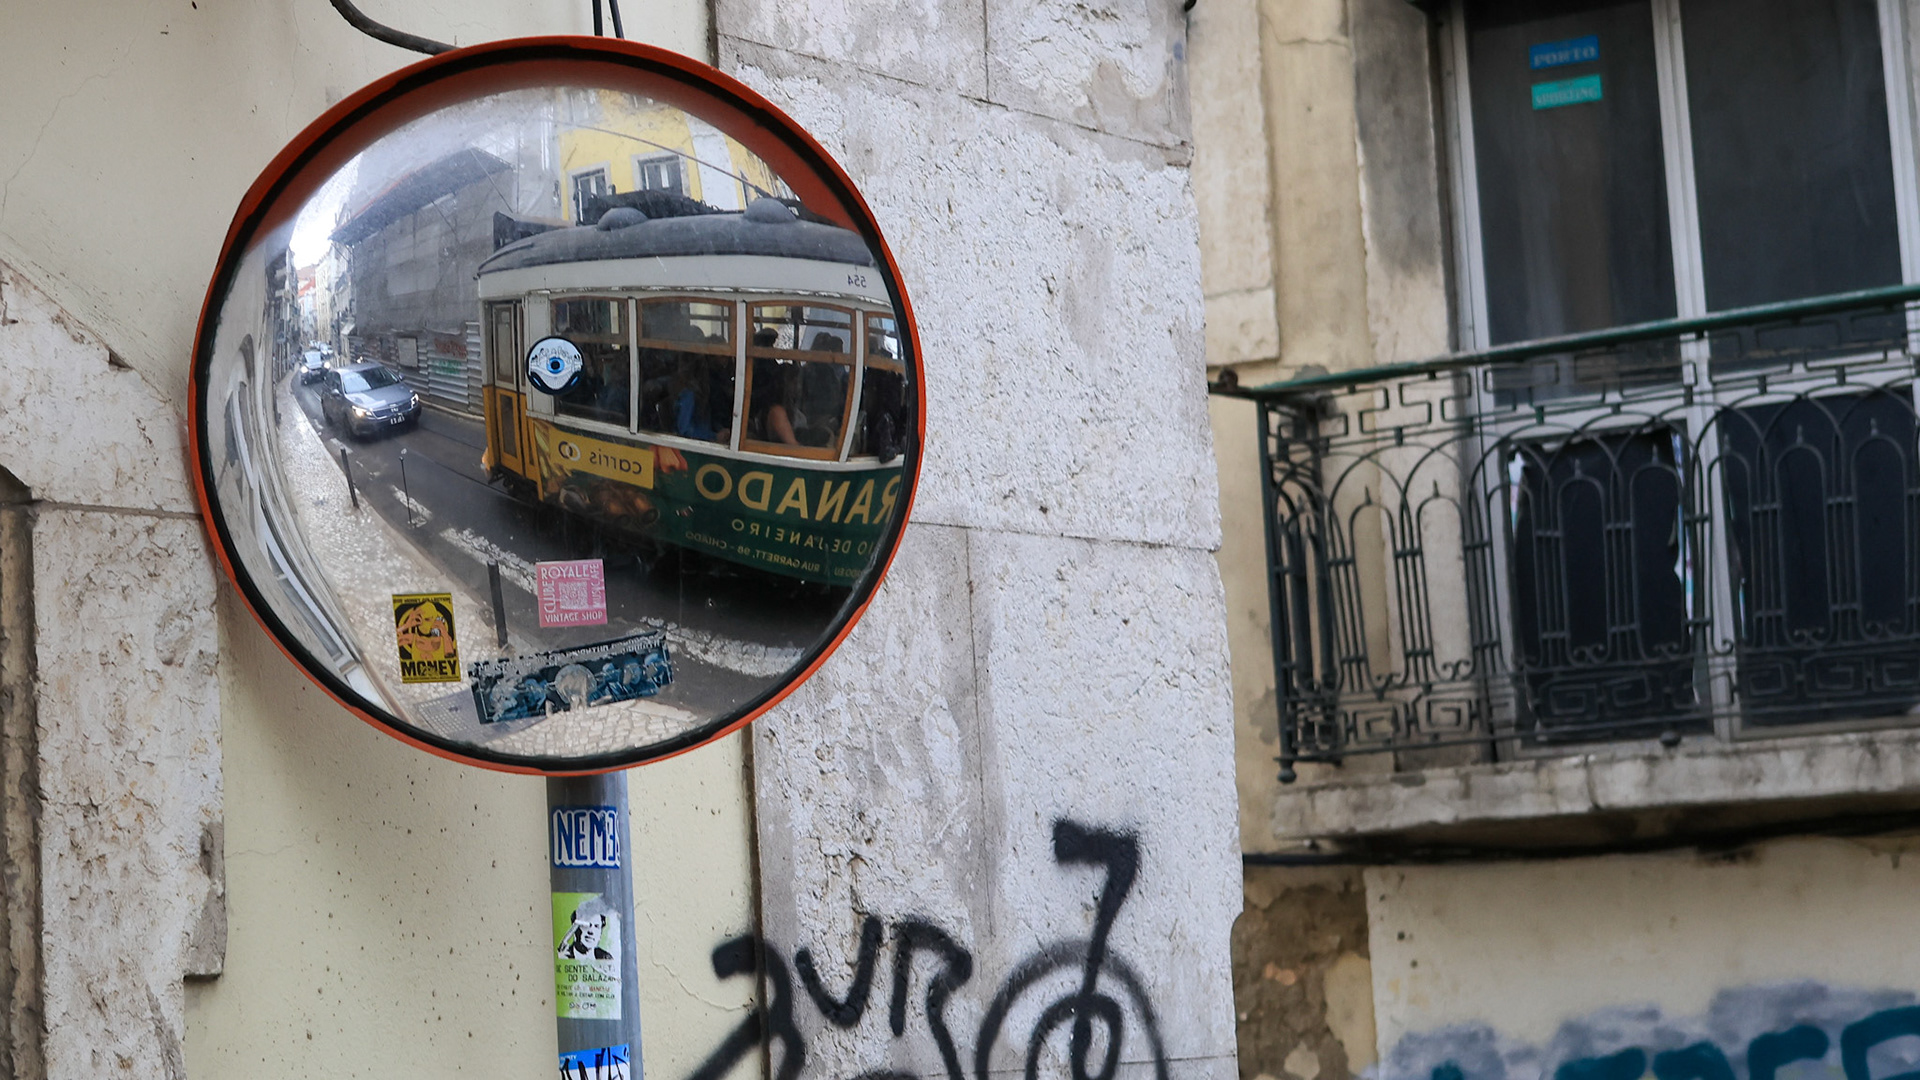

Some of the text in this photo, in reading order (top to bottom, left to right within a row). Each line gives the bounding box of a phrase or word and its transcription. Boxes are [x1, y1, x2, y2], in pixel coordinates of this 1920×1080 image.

[1534, 46, 1596, 67] PORTO
[541, 565, 589, 580] ROYALE
[542, 580, 556, 613] CLUBE
[545, 611, 603, 623] VINTAGE SHOP
[401, 660, 457, 677] MONEY
[564, 964, 589, 973] SENTE
[568, 974, 578, 982] DO
